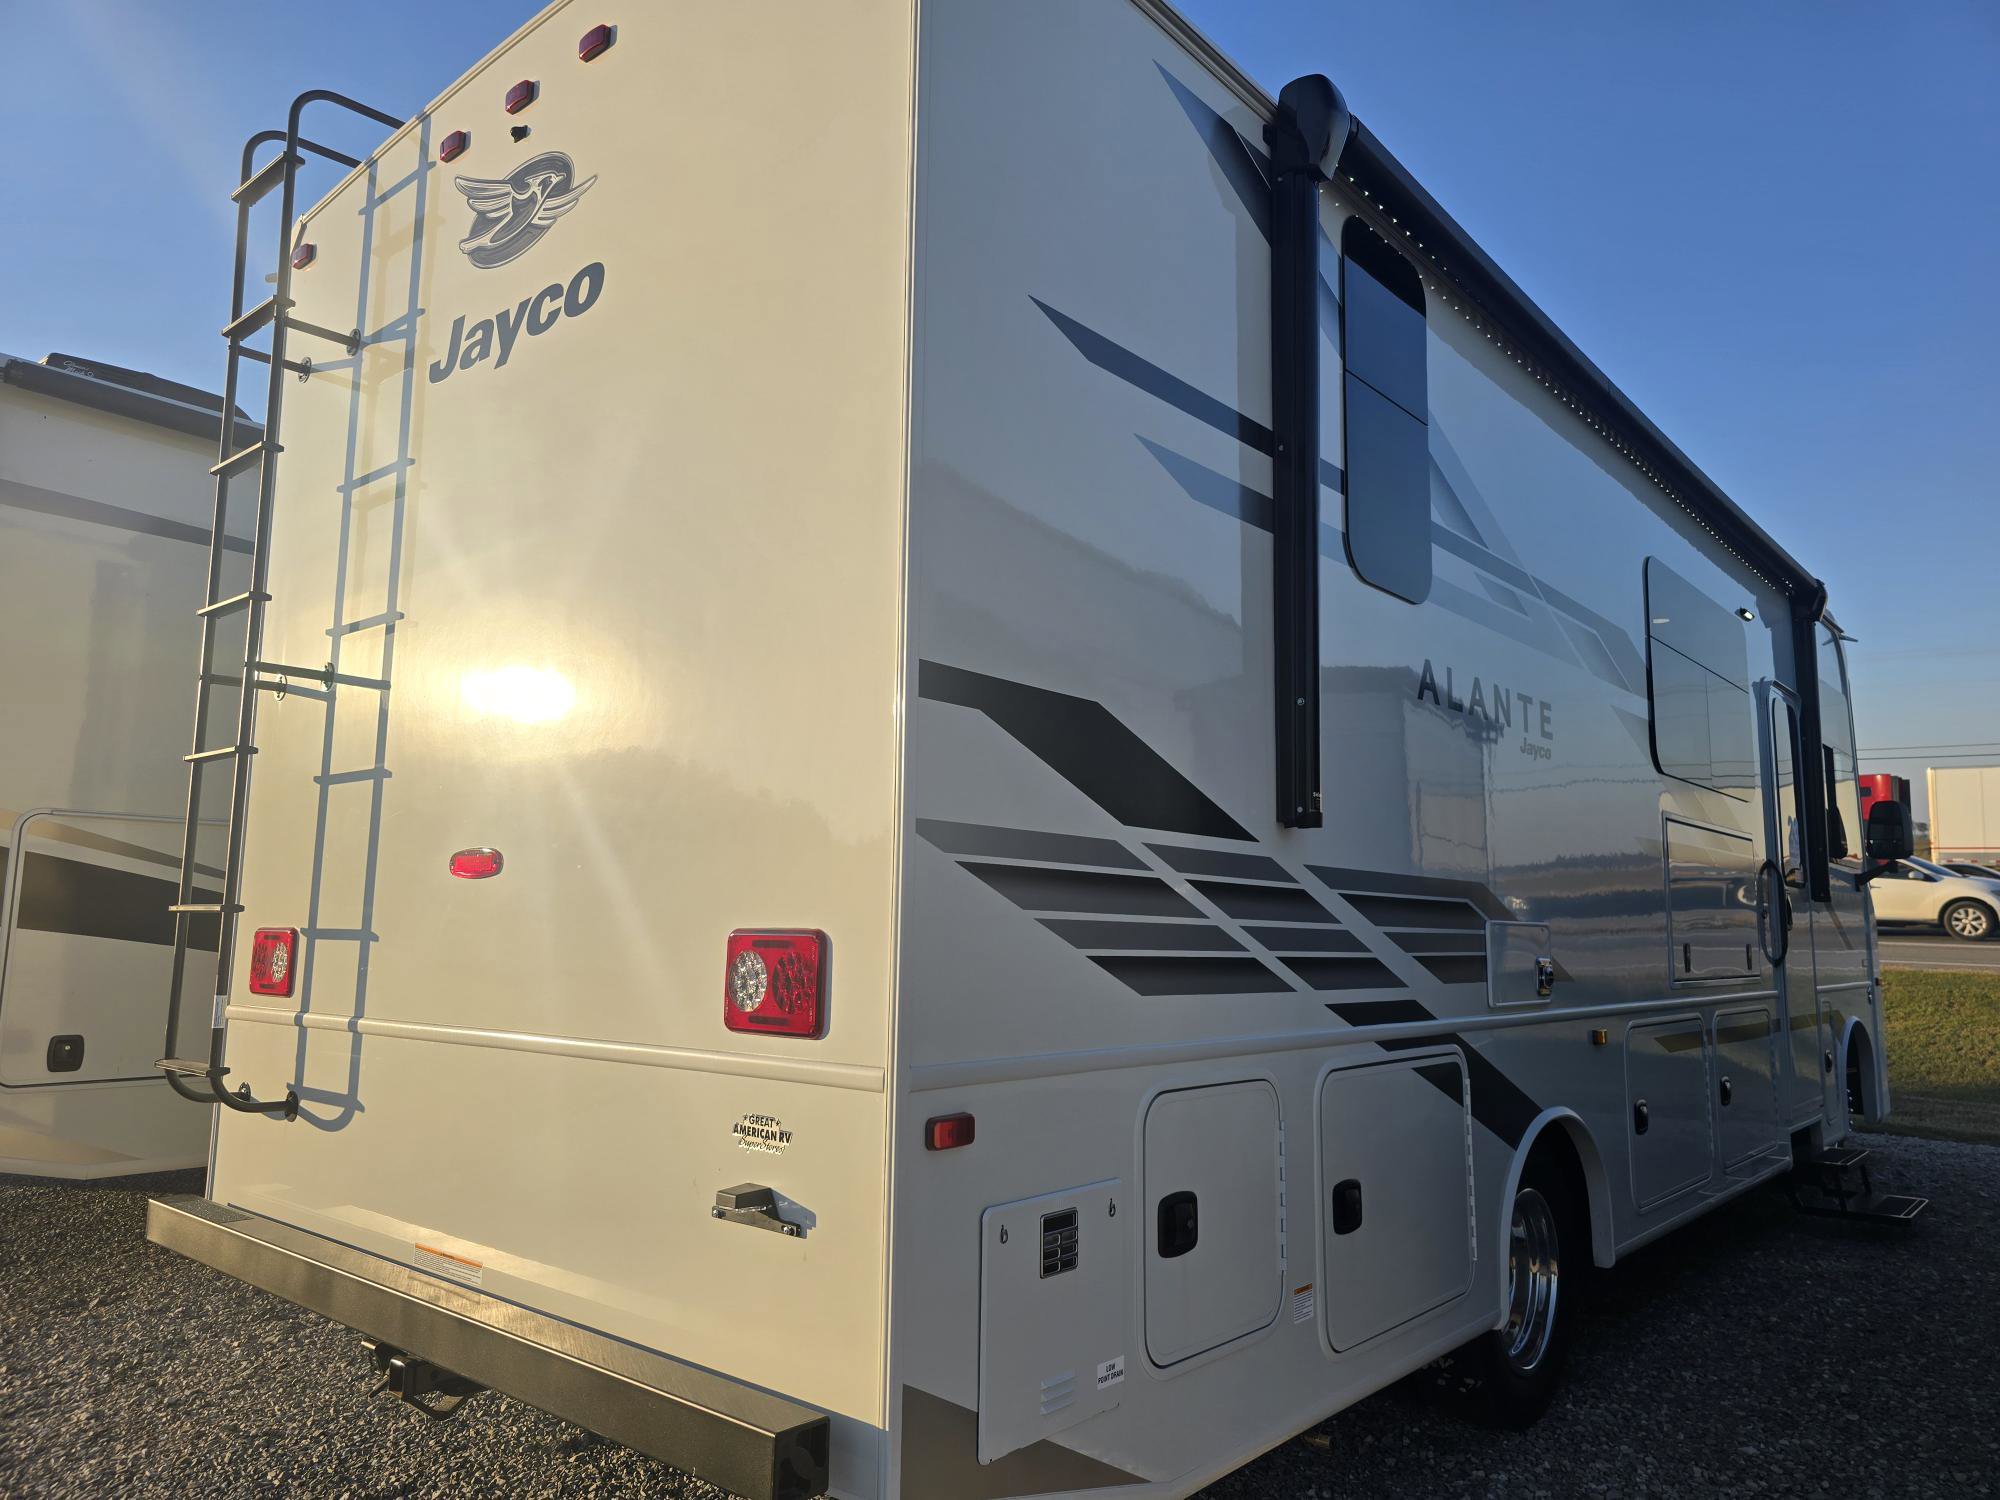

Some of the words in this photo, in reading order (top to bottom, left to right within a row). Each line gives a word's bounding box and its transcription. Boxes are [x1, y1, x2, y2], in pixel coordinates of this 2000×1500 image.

[429, 262, 605, 383] Jayco
[1417, 658, 1553, 741] ALANTE
[1520, 737, 1552, 760] Jayco
[748, 1114, 775, 1128] GREAT
[733, 1122, 777, 1142] AMERICAN
[778, 1131, 792, 1144] RV
[1098, 1373, 1110, 1384] POINT
[1111, 1369, 1124, 1380] DRAIN
[1106, 1363, 1116, 1372] LOW
